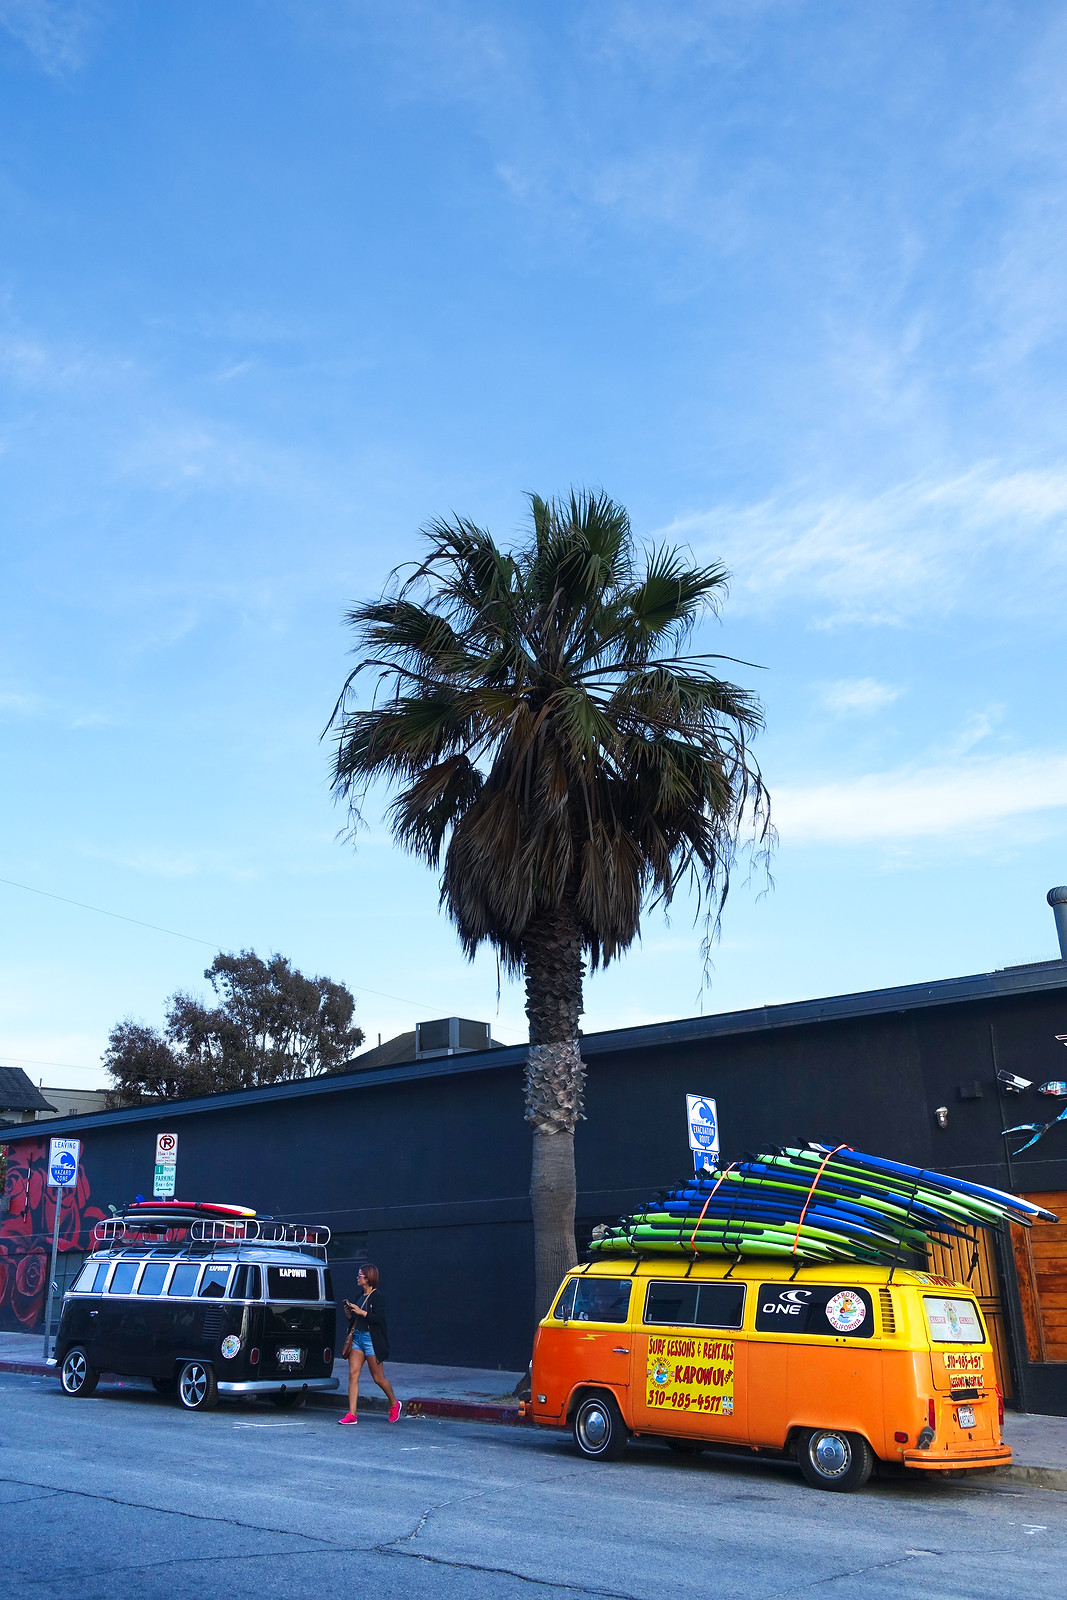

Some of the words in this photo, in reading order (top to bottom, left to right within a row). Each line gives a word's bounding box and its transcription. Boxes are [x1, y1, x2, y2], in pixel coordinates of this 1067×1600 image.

[54, 1141, 76, 1150] LEAVING
[279, 1268, 307, 1278] KAPOWUI
[833, 1291, 862, 1305] KAPOWUI
[762, 1304, 802, 1314] ONE
[830, 1316, 861, 1331] CALIFORNIA
[648, 1338, 666, 1356] SURF
[667, 1340, 696, 1358] LESSONS
[697, 1341, 702, 1357] &
[703, 1342, 734, 1361] RENTALS
[674, 1365, 725, 1386] KAPOWUI
[648, 1390, 722, 1412] 310-985-4577
